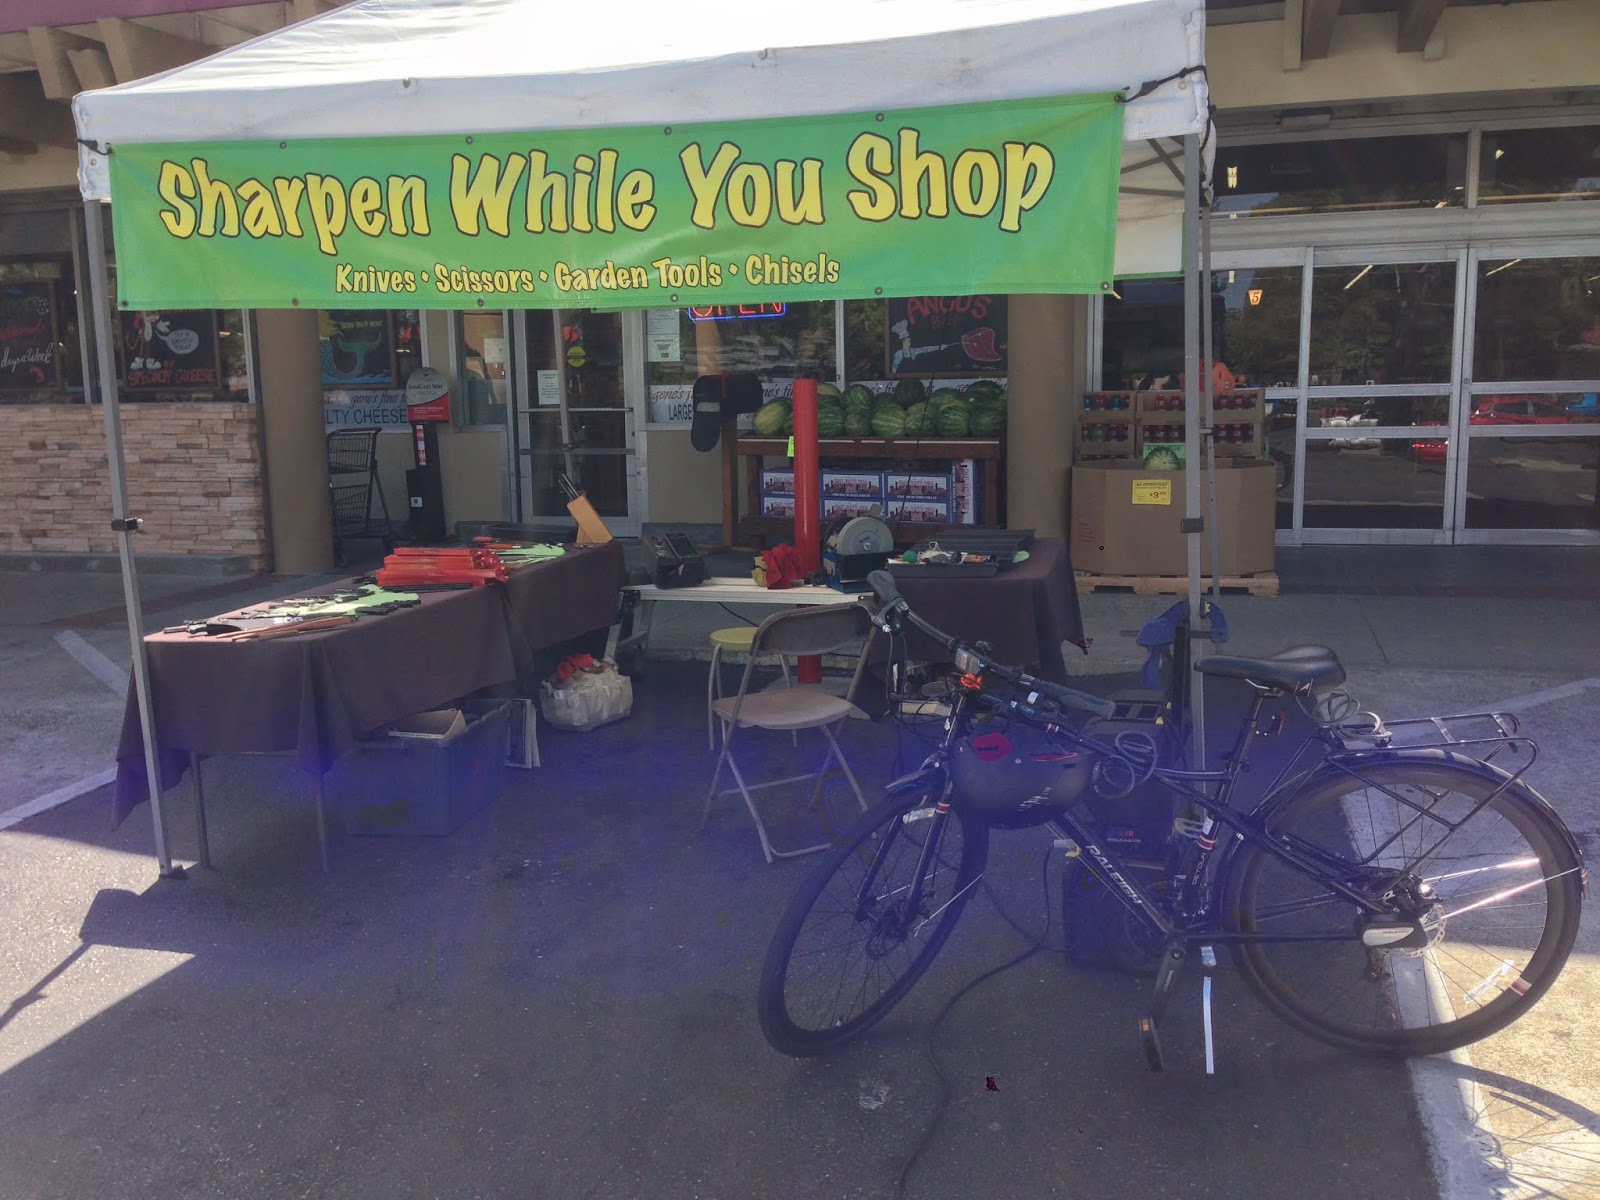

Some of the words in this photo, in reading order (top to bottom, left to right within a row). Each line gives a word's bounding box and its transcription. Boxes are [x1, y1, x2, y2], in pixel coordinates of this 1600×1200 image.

[157, 157, 431, 256] Sharpen
[449, 149, 656, 238] While
[679, 140, 825, 230] You
[846, 127, 1056, 233] Shop
[335, 264, 416, 294] Knives
[434, 262, 534, 294] Scissors
[554, 261, 649, 292] Garden
[652, 255, 723, 288] Tools
[744, 253, 840, 286] Chisels
[1251, 290, 1260, 302] 5
[349, 389, 378, 409] gene's
[652, 385, 684, 406] gene's
[353, 408, 408, 425] CHEESE
[668, 403, 692, 421] LARGE
[1085, 845, 1143, 904] RALEIGH
[1191, 851, 1206, 885] DETOUR
